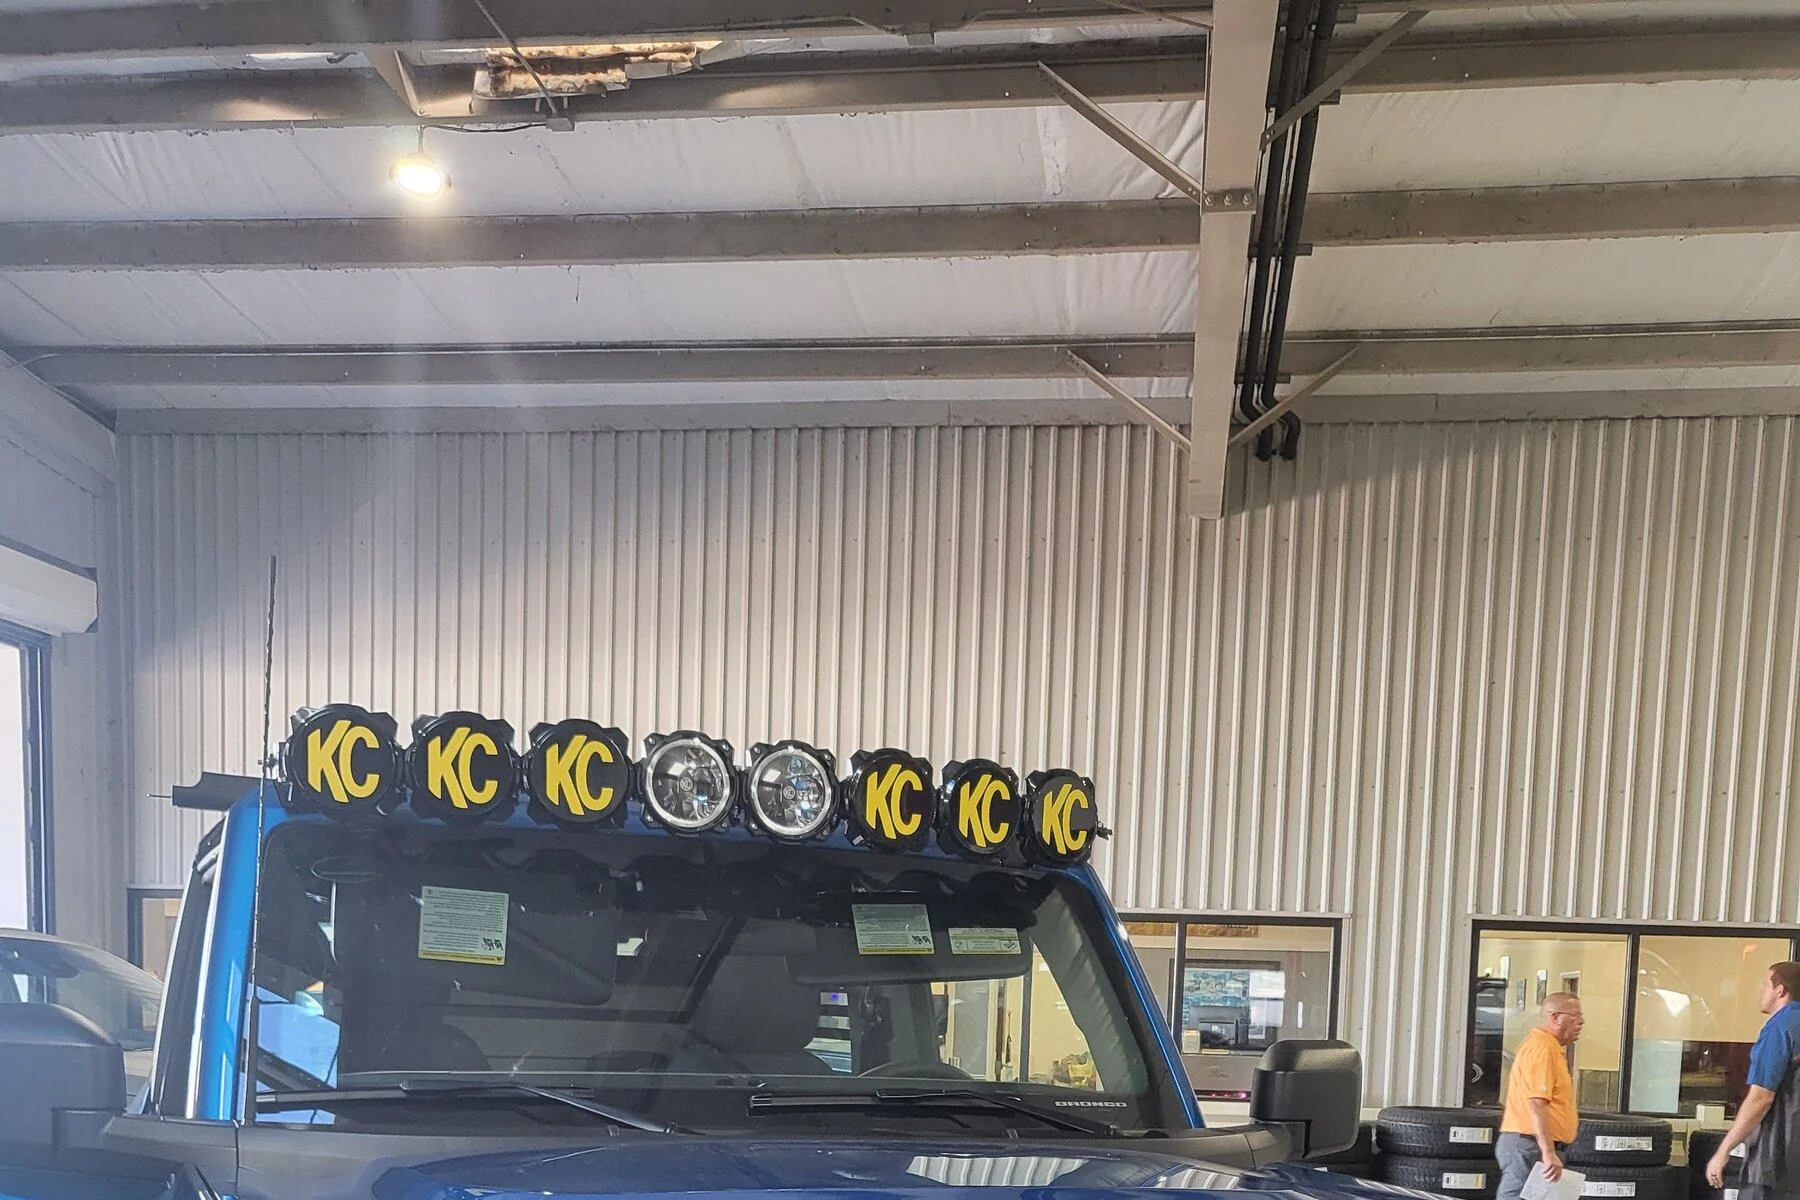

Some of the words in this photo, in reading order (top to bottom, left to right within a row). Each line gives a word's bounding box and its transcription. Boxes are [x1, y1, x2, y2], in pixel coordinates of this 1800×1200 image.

[307, 719, 380, 803] KC
[426, 727, 498, 809] KC
[545, 734, 614, 815] KC
[866, 763, 922, 839] KC
[958, 774, 1010, 847] KC
[1042, 784, 1089, 855] KC
